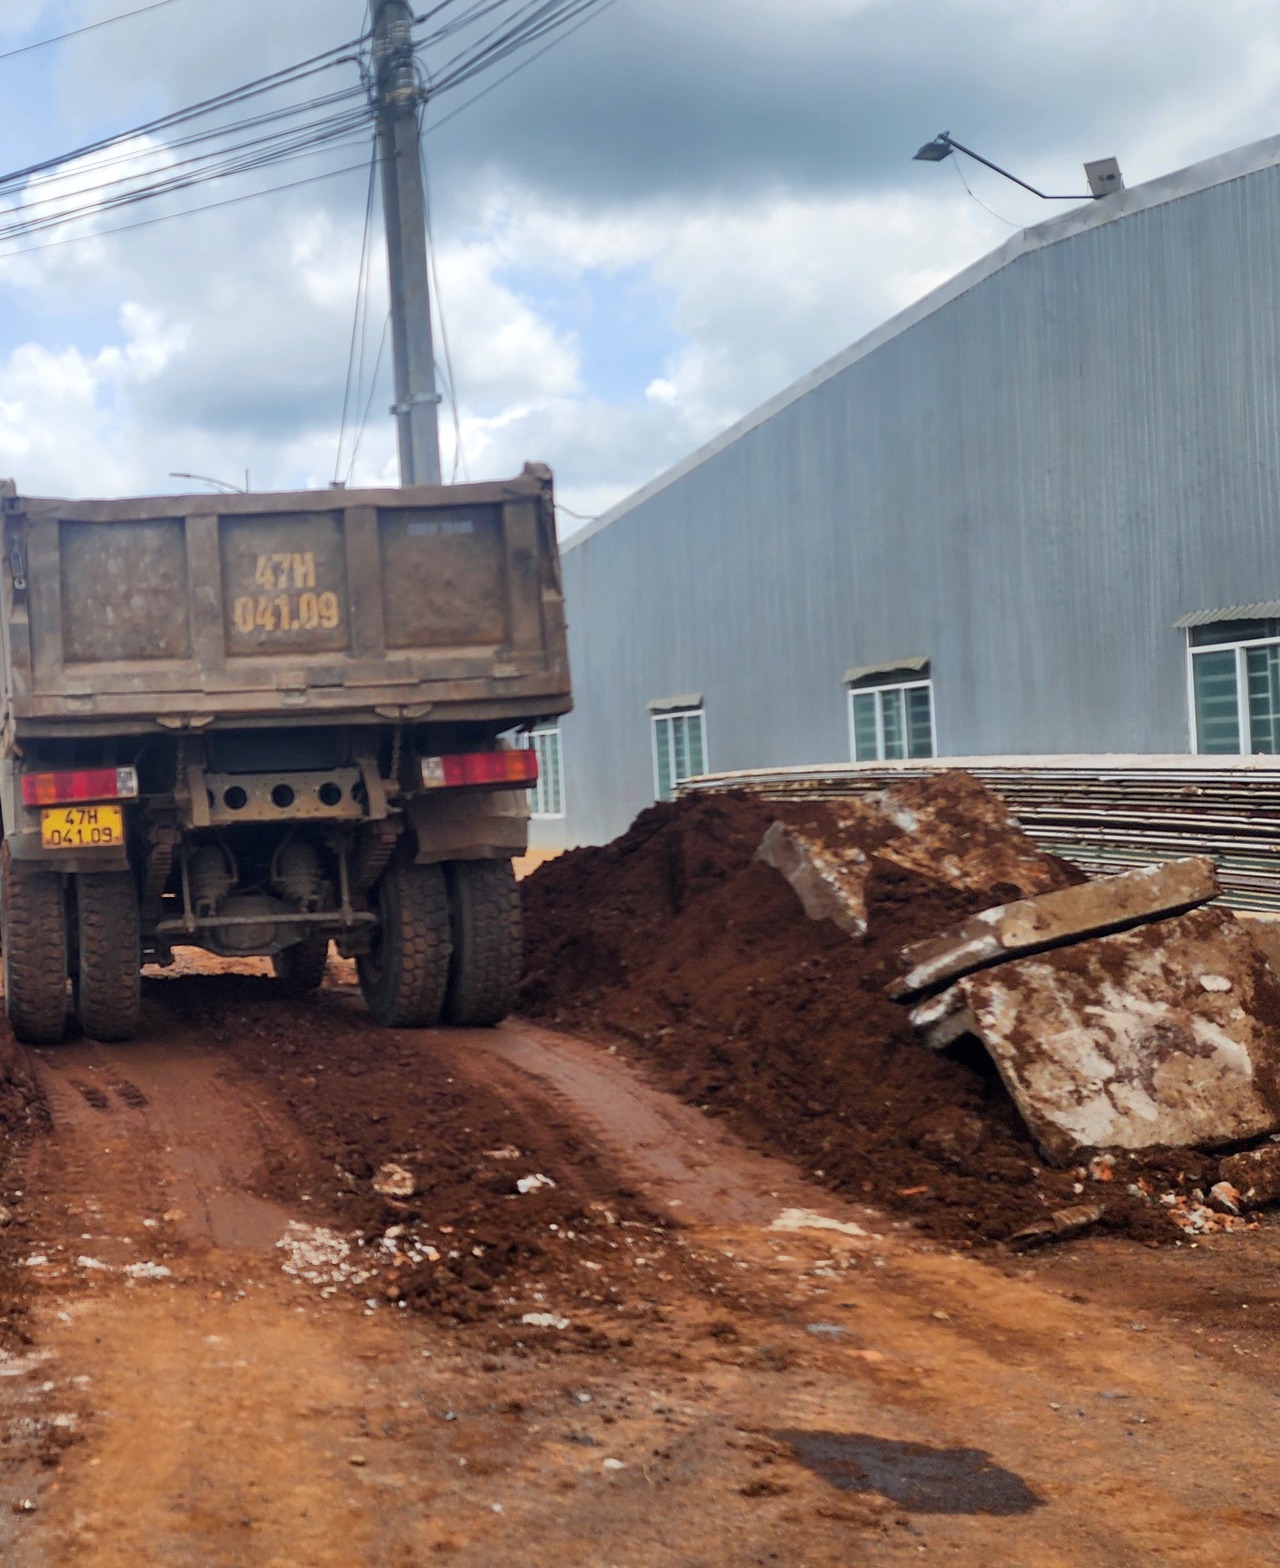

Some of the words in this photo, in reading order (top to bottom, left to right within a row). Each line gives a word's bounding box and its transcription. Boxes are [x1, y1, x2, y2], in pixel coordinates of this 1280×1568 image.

[255, 551, 316, 590] 47H
[234, 591, 339, 633] 041.09
[64, 808, 98, 825] 47H
